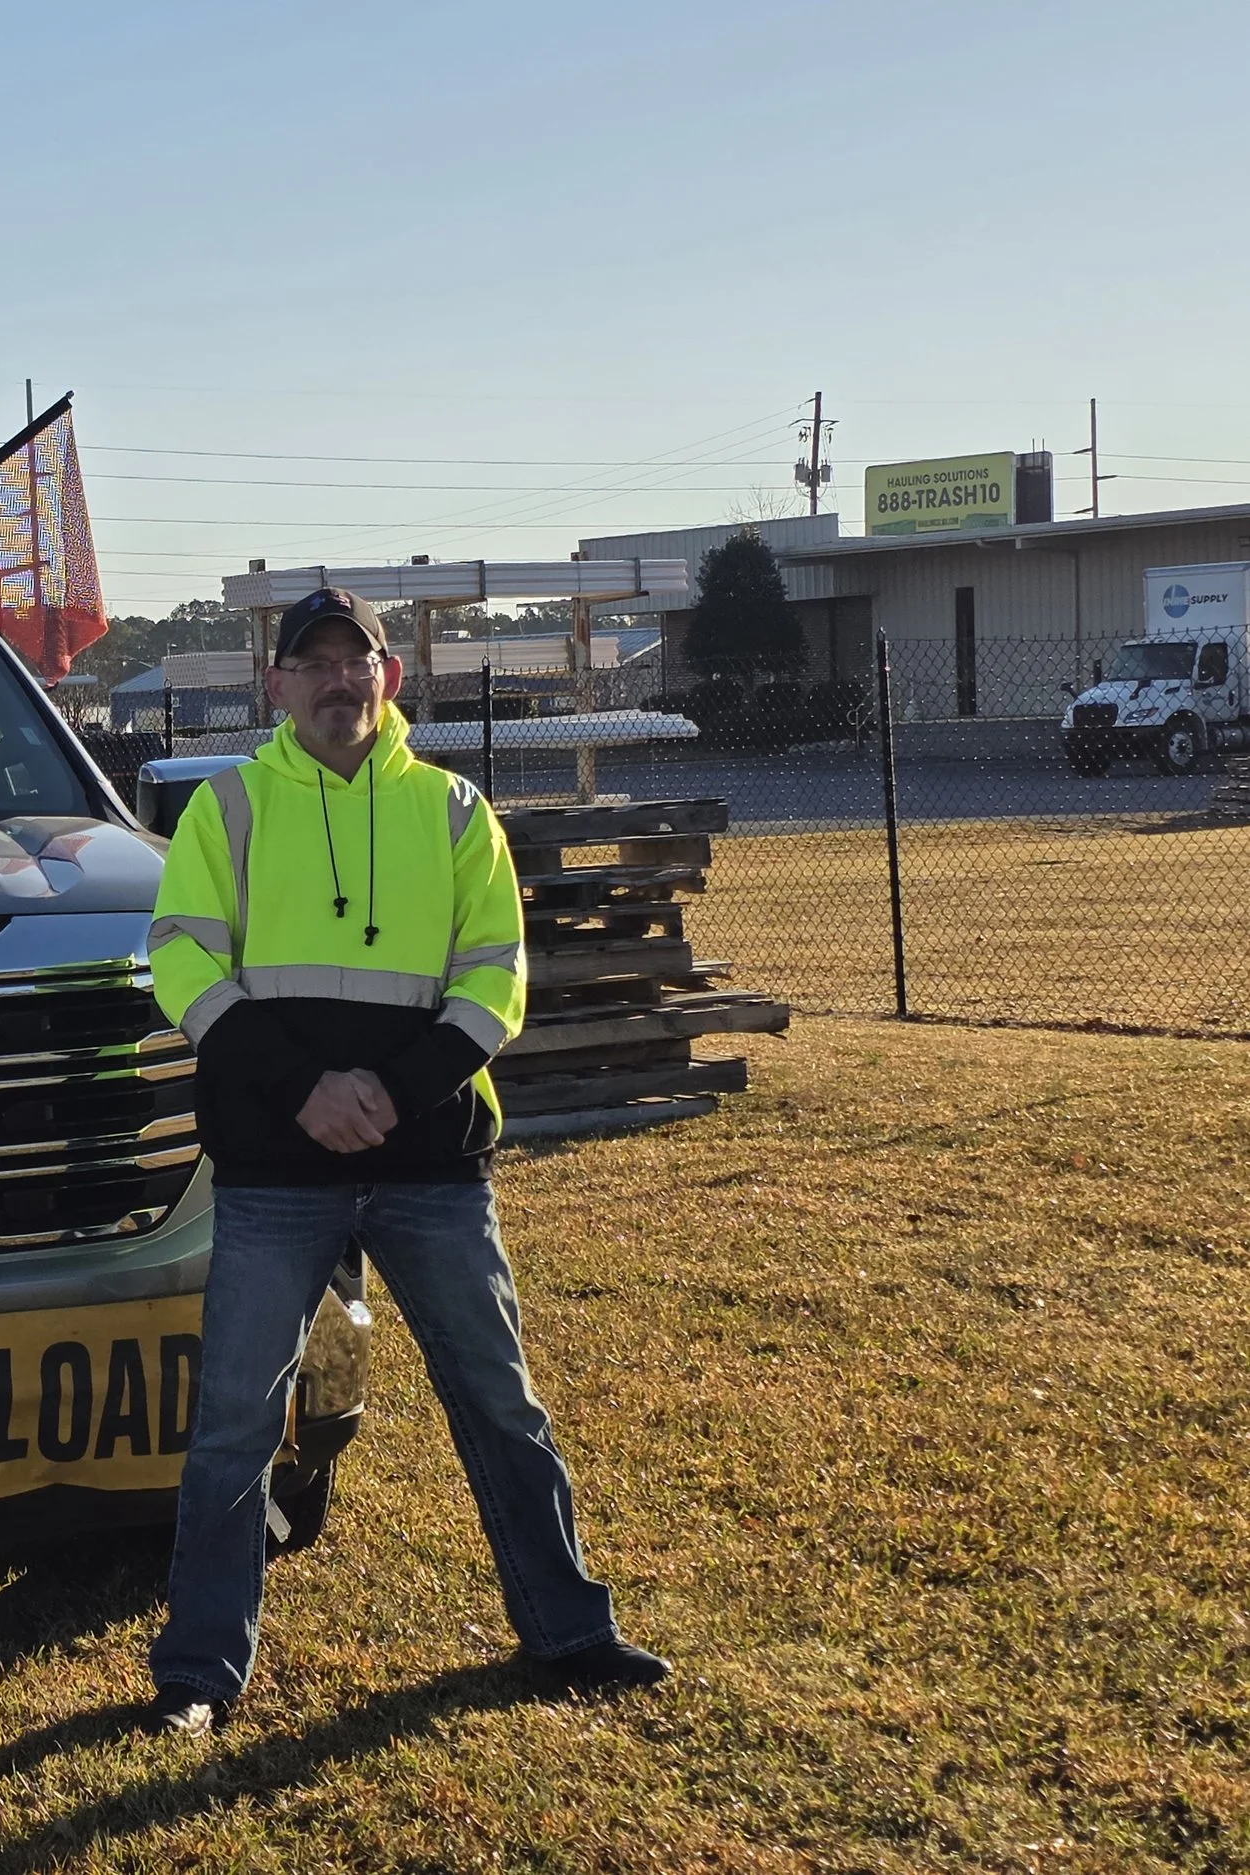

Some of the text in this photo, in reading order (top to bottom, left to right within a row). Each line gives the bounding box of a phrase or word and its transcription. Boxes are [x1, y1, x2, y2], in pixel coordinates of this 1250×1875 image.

[887, 468, 989, 488] HAULING SOLUTIONS
[1190, 593, 1229, 605] SUPPLY
